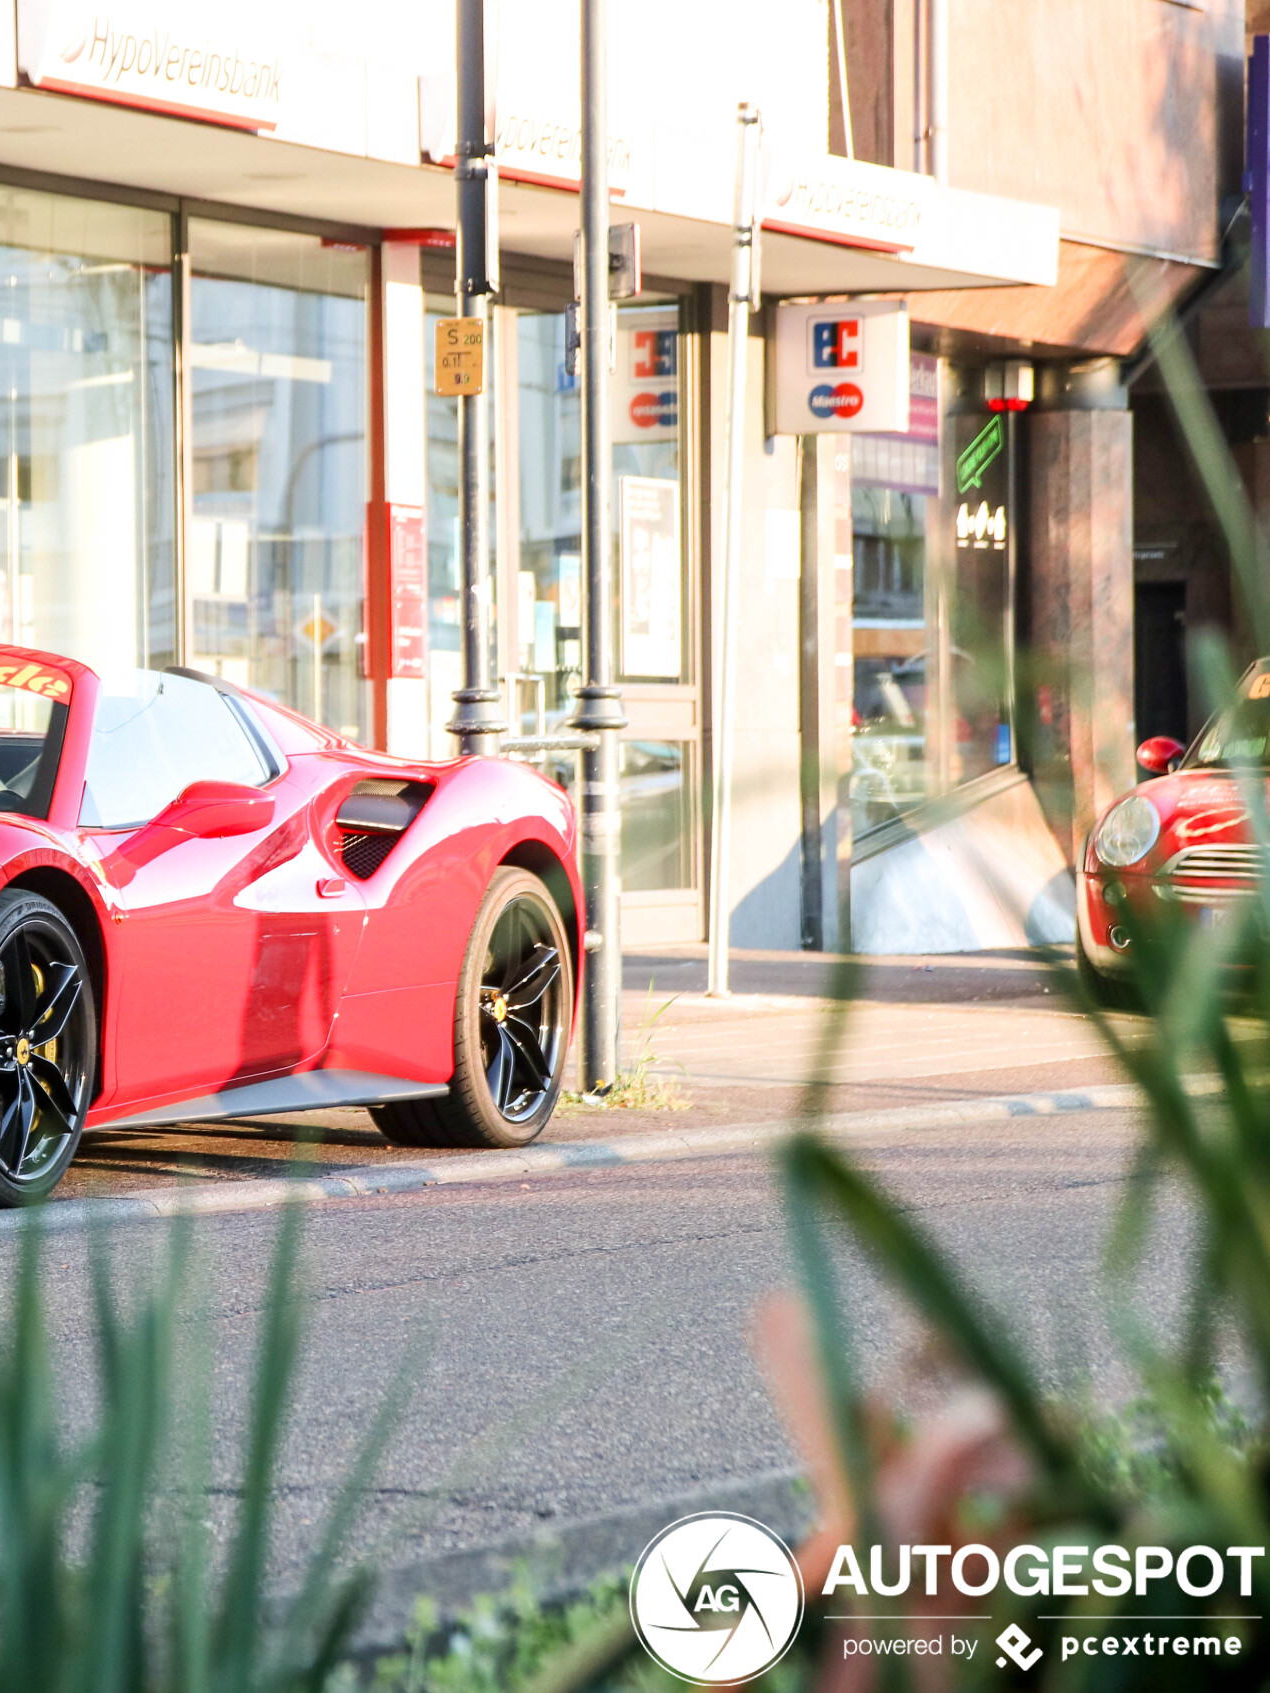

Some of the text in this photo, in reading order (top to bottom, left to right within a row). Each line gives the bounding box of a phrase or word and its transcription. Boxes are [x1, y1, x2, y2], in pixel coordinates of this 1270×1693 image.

[88, 14, 282, 102] HypoVereinsbank
[447, 328, 482, 345] S 200
[813, 319, 858, 368] EC
[811, 394, 859, 409] Maestro
